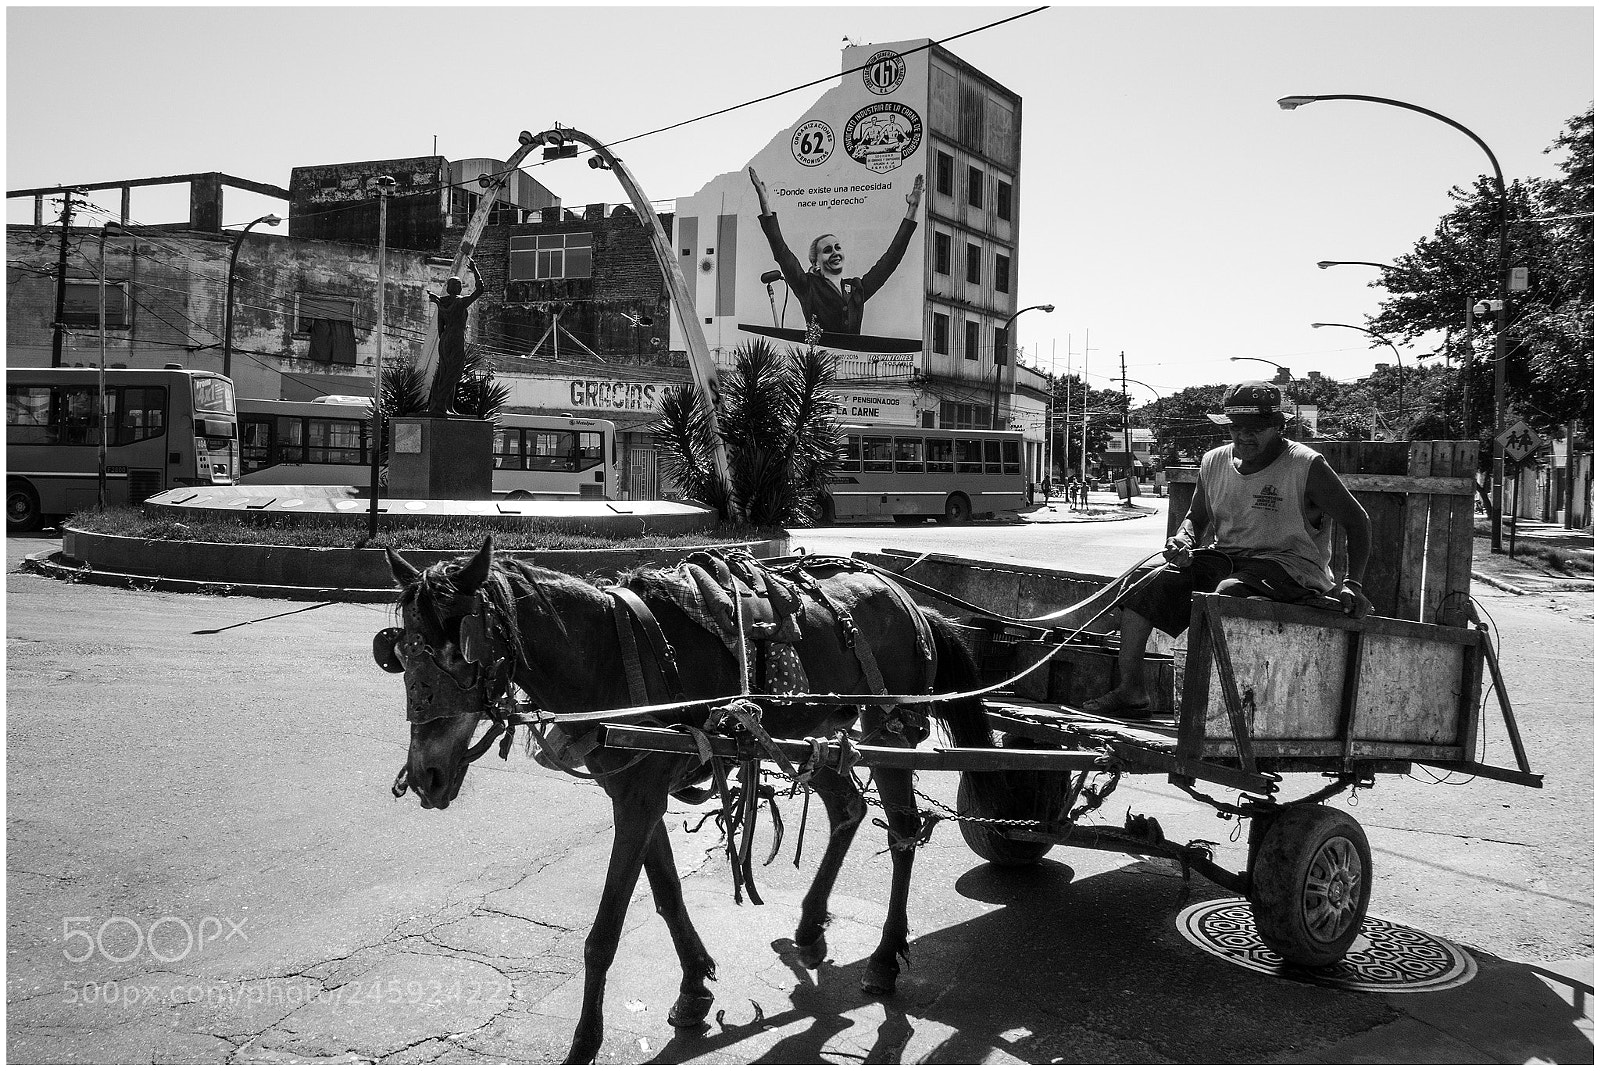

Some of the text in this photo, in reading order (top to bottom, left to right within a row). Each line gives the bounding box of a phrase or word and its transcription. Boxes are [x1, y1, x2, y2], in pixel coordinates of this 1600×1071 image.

[855, 104, 884, 122] INDUSTRIA
[893, 103, 902, 112] LA
[901, 106, 919, 124] CARNE
[794, 123, 832, 145] ORGANIZACIONES
[800, 131, 824, 155] 62
[797, 151, 829, 164] PERONISTAS
[808, 186, 832, 195] existe
[833, 185, 848, 193] una
[850, 182, 892, 192] necesidad
[818, 199, 828, 207] un
[570, 380, 656, 410] GRACIAS
[852, 396, 900, 405] PENSIONADOS
[836, 407, 848, 415] LA
[851, 407, 880, 417] CARNE
